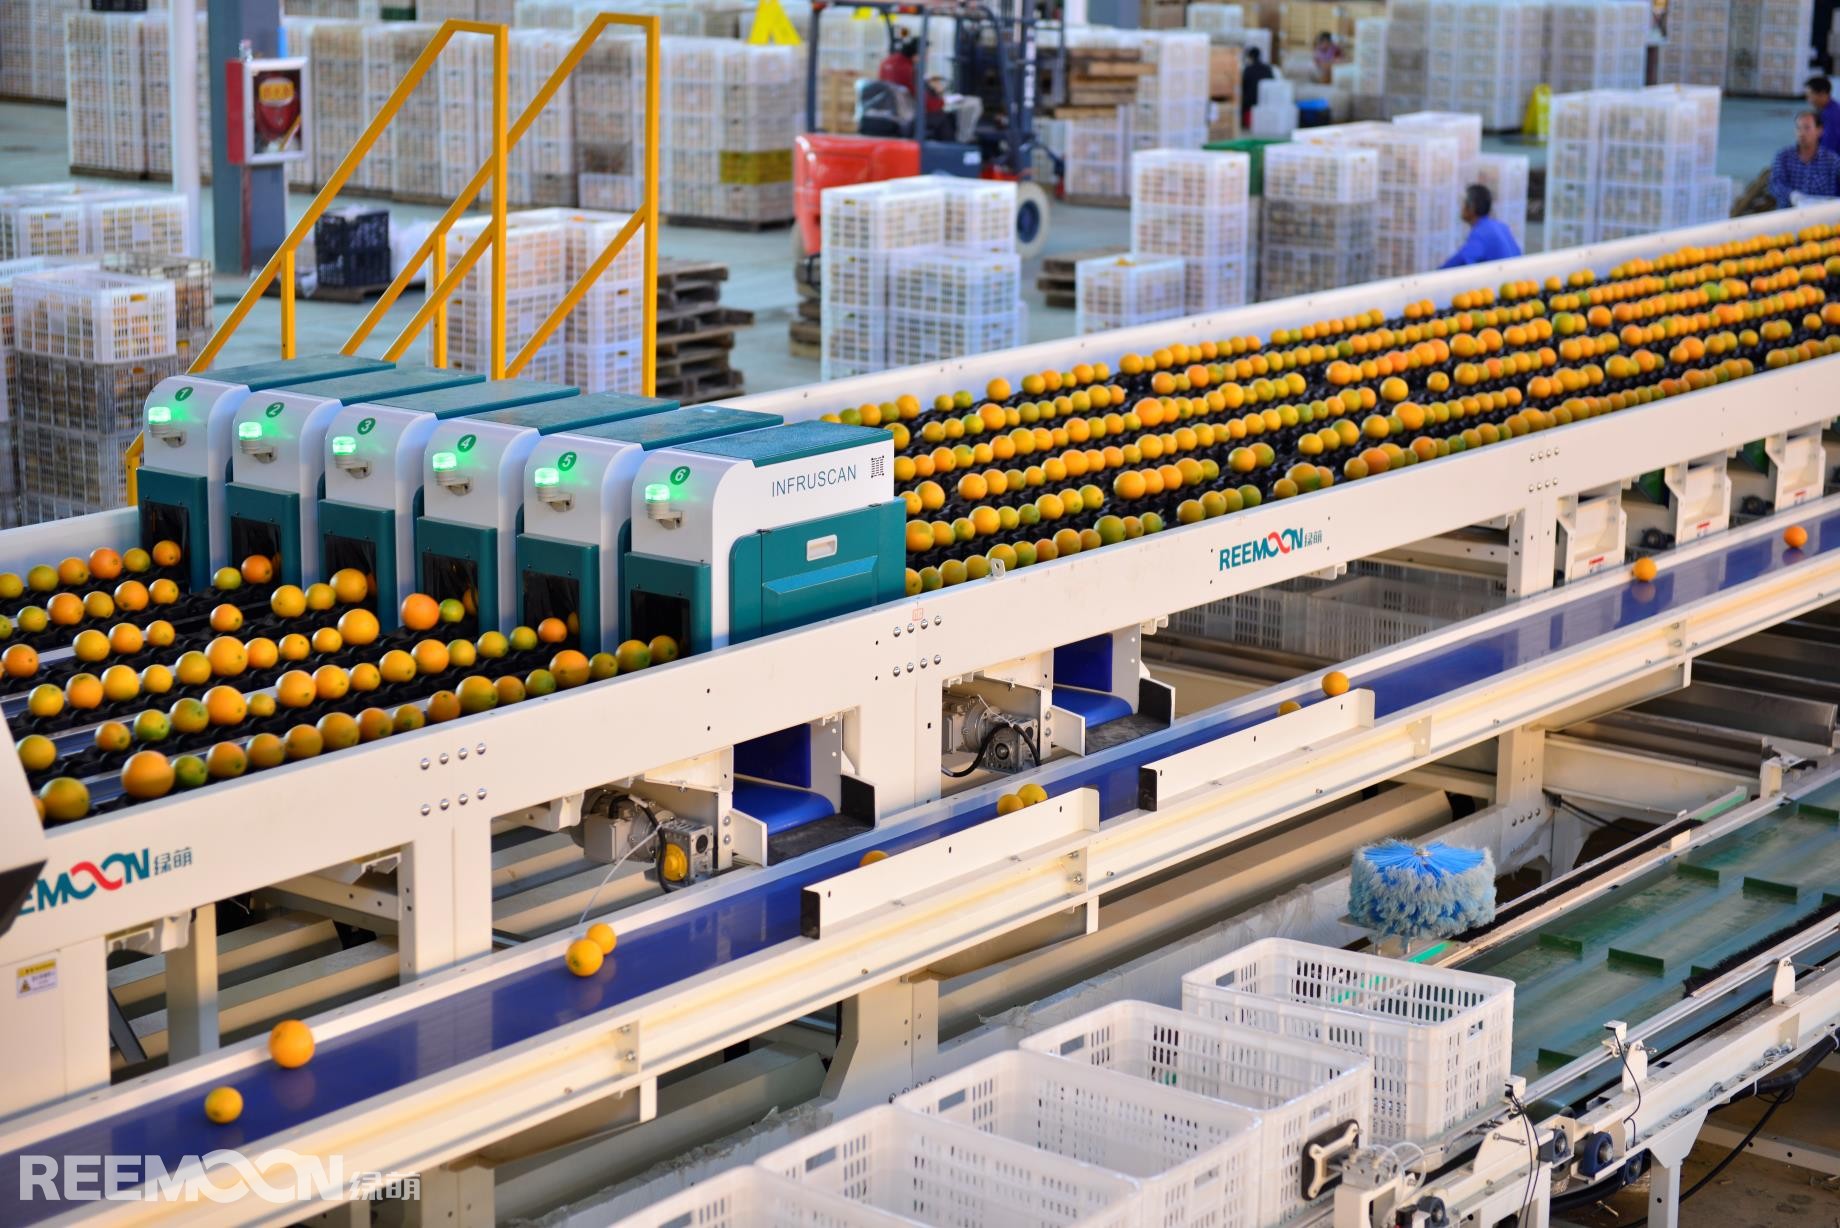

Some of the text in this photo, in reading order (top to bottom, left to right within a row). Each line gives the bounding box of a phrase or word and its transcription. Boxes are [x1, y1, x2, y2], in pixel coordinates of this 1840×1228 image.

[772, 464, 857, 497] INFRUSCAN
[1219, 527, 1304, 571] REEMOON
[154, 846, 193, 876] 绿萌
